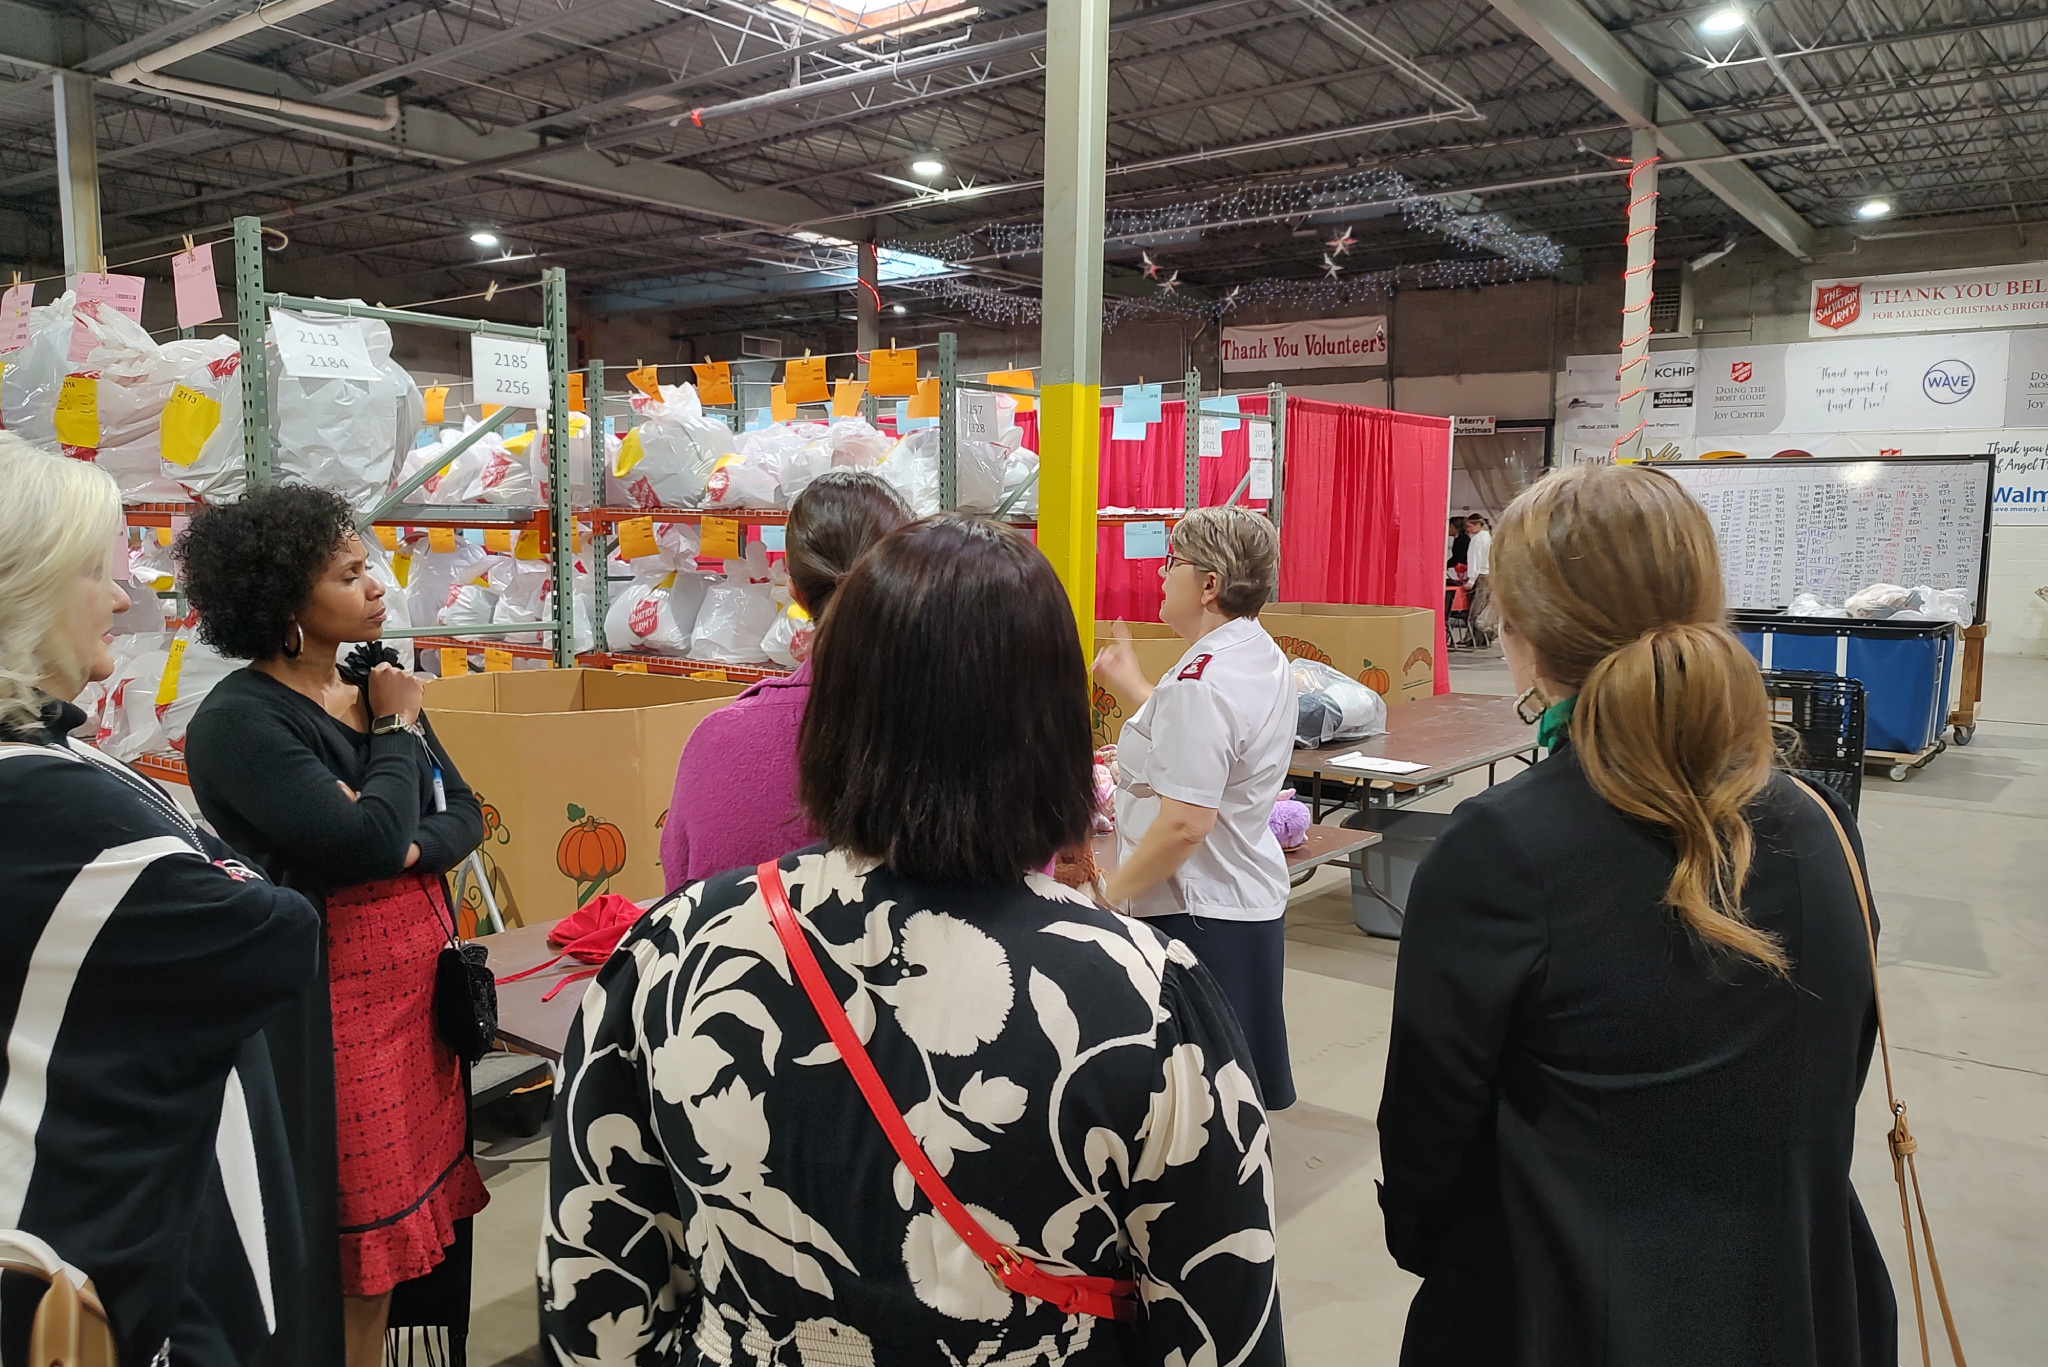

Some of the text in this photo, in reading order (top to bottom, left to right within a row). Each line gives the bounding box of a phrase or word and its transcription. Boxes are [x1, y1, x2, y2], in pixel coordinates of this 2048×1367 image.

[1823, 288, 1842, 304] THE
[1870, 287, 1947, 304] THANK
[1954, 282, 2000, 299] YOU
[1816, 289, 1858, 321] SALVATION
[1872, 312, 1893, 320] FOR
[1896, 308, 1941, 319] MAKING
[1943, 303, 2009, 315] CHRISTMAS
[1830, 302, 1857, 326] ARMY
[297, 330, 339, 347] 2113
[1222, 338, 1267, 361] Thank
[1273, 336, 1299, 358] You
[306, 354, 349, 369] 2184
[494, 353, 528, 369] 2185
[1654, 366, 1695, 378] KCHIP
[1816, 365, 1888, 380] Thank you for
[496, 379, 530, 395] 2256
[1815, 381, 1891, 398] your support of
[1928, 376, 1970, 388] WAVE
[178, 390, 198, 404] 2113
[1716, 386, 1747, 395] DOING
[1822, 396, 1886, 412] Angel Tree!
[2026, 399, 2045, 410] JOY
[1459, 417, 1486, 425] Merry
[1714, 410, 1765, 421] JOY CENTER
[1987, 441, 2021, 455] Thank
[2023, 445, 2044, 457] you
[2004, 457, 2039, 474] Angel
[1696, 466, 1743, 485] READY
[1757, 464, 1801, 481] FOR
[1810, 529, 1834, 540] PLEASE
[635, 617, 655, 633] ARMY
